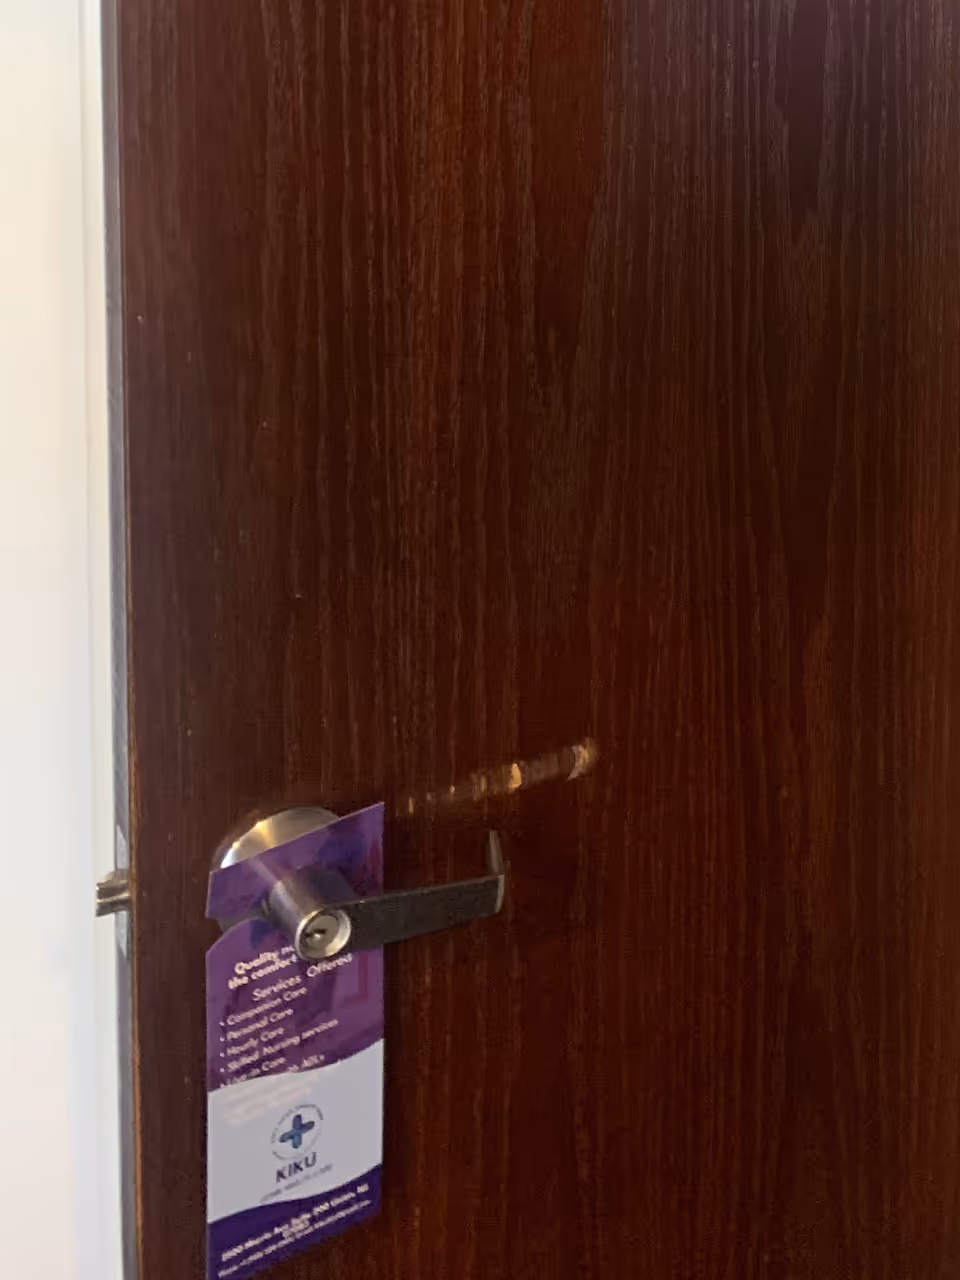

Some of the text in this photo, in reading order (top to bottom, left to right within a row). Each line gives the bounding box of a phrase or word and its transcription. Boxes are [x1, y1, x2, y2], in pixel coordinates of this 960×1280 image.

[252, 953, 352, 1001] Services Offered
[227, 987, 308, 1025] Companion Care
[270, 1009, 294, 1023] Care
[260, 1026, 284, 1041] Care
[262, 1057, 286, 1071] Care
[275, 1151, 317, 1183] KIKU
